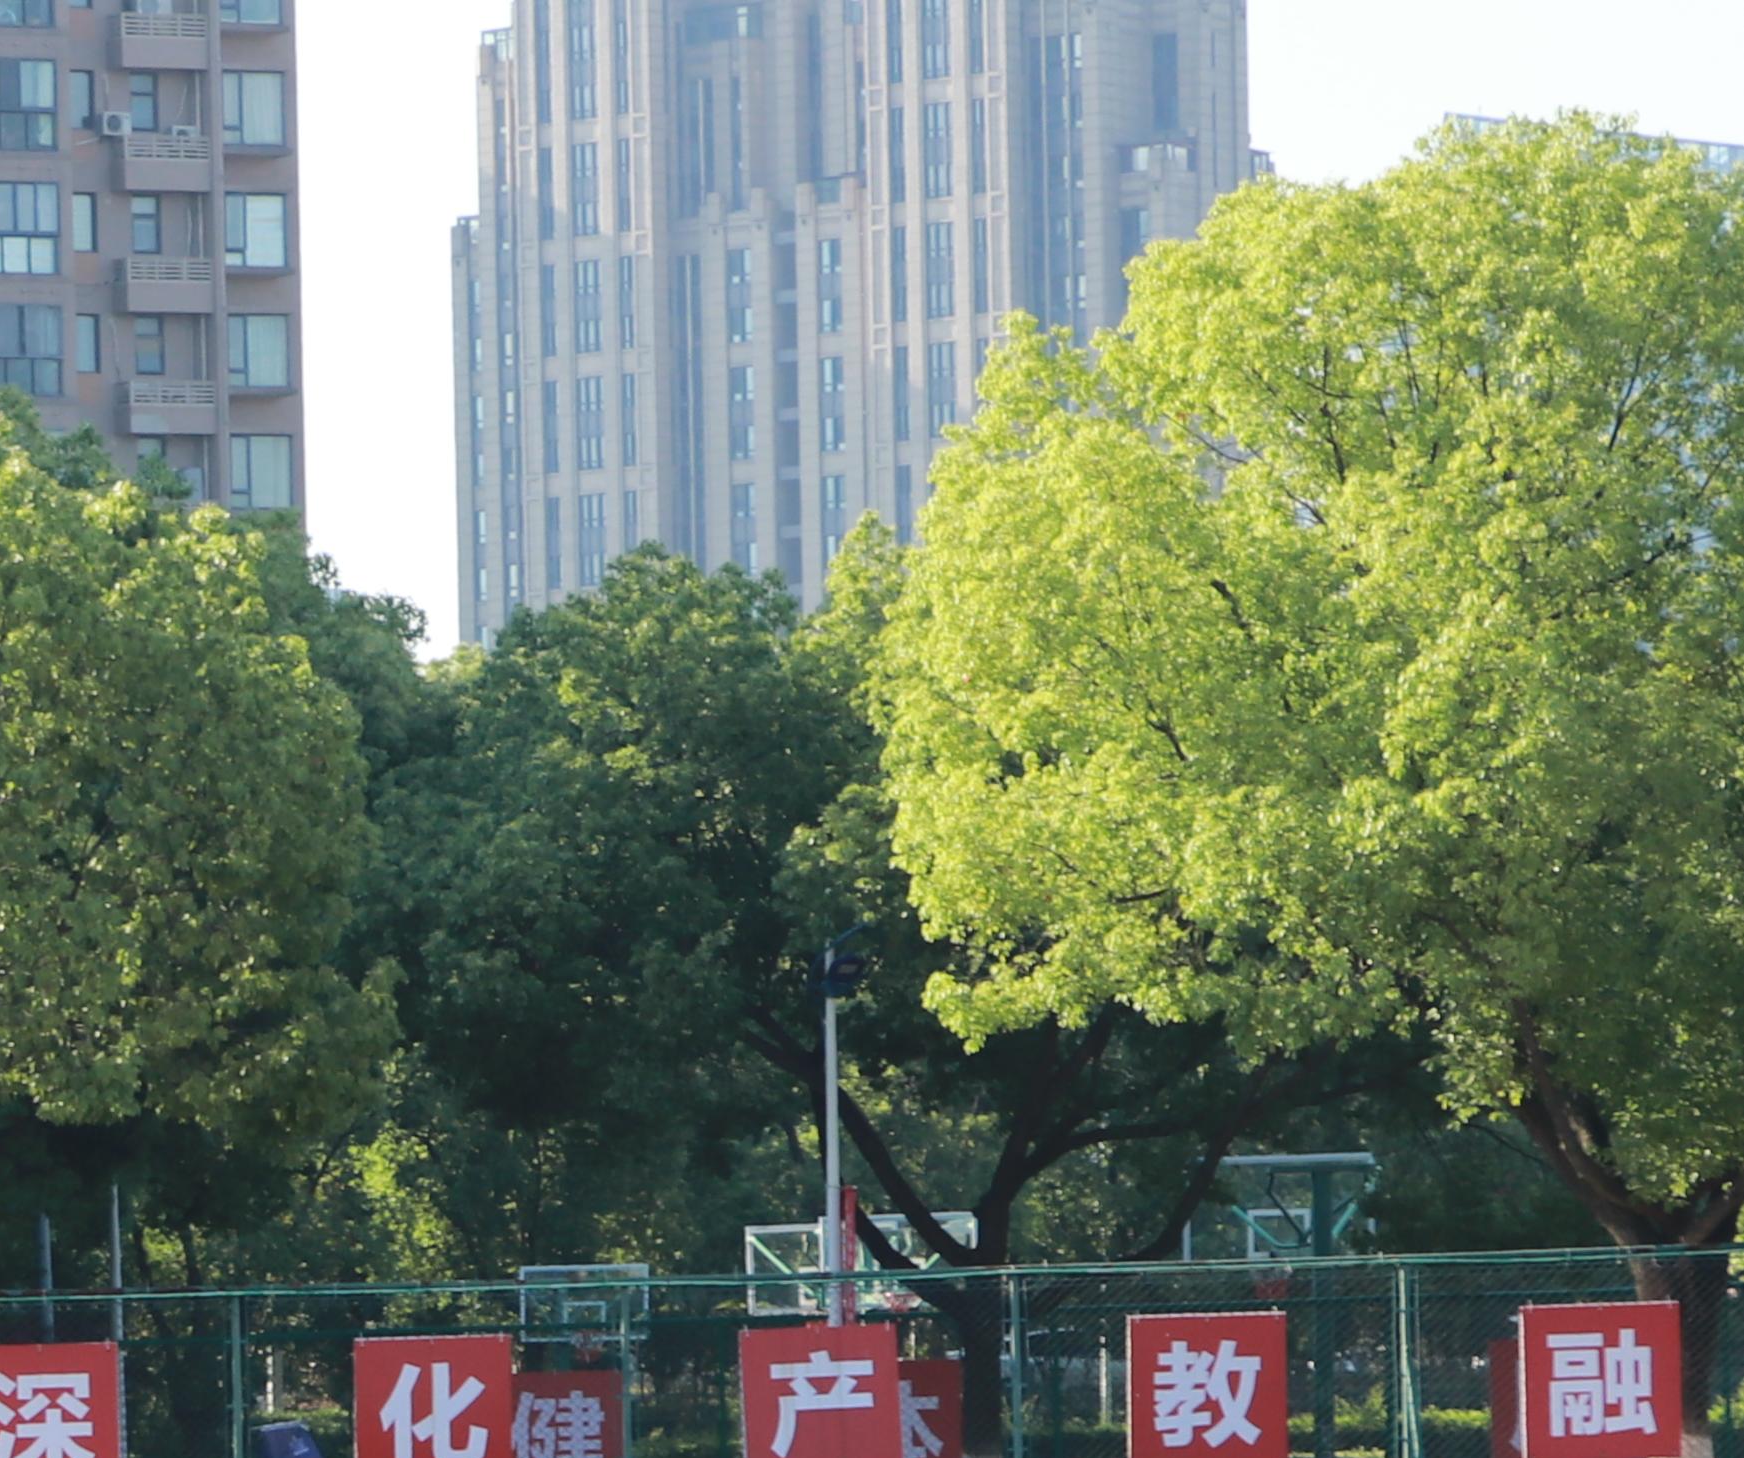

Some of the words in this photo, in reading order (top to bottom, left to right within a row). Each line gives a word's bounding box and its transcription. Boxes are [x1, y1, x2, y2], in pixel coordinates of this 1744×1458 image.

[770, 1350, 874, 1458] 产
[1153, 1340, 1262, 1448] 教
[1546, 1328, 1658, 1438] 融
